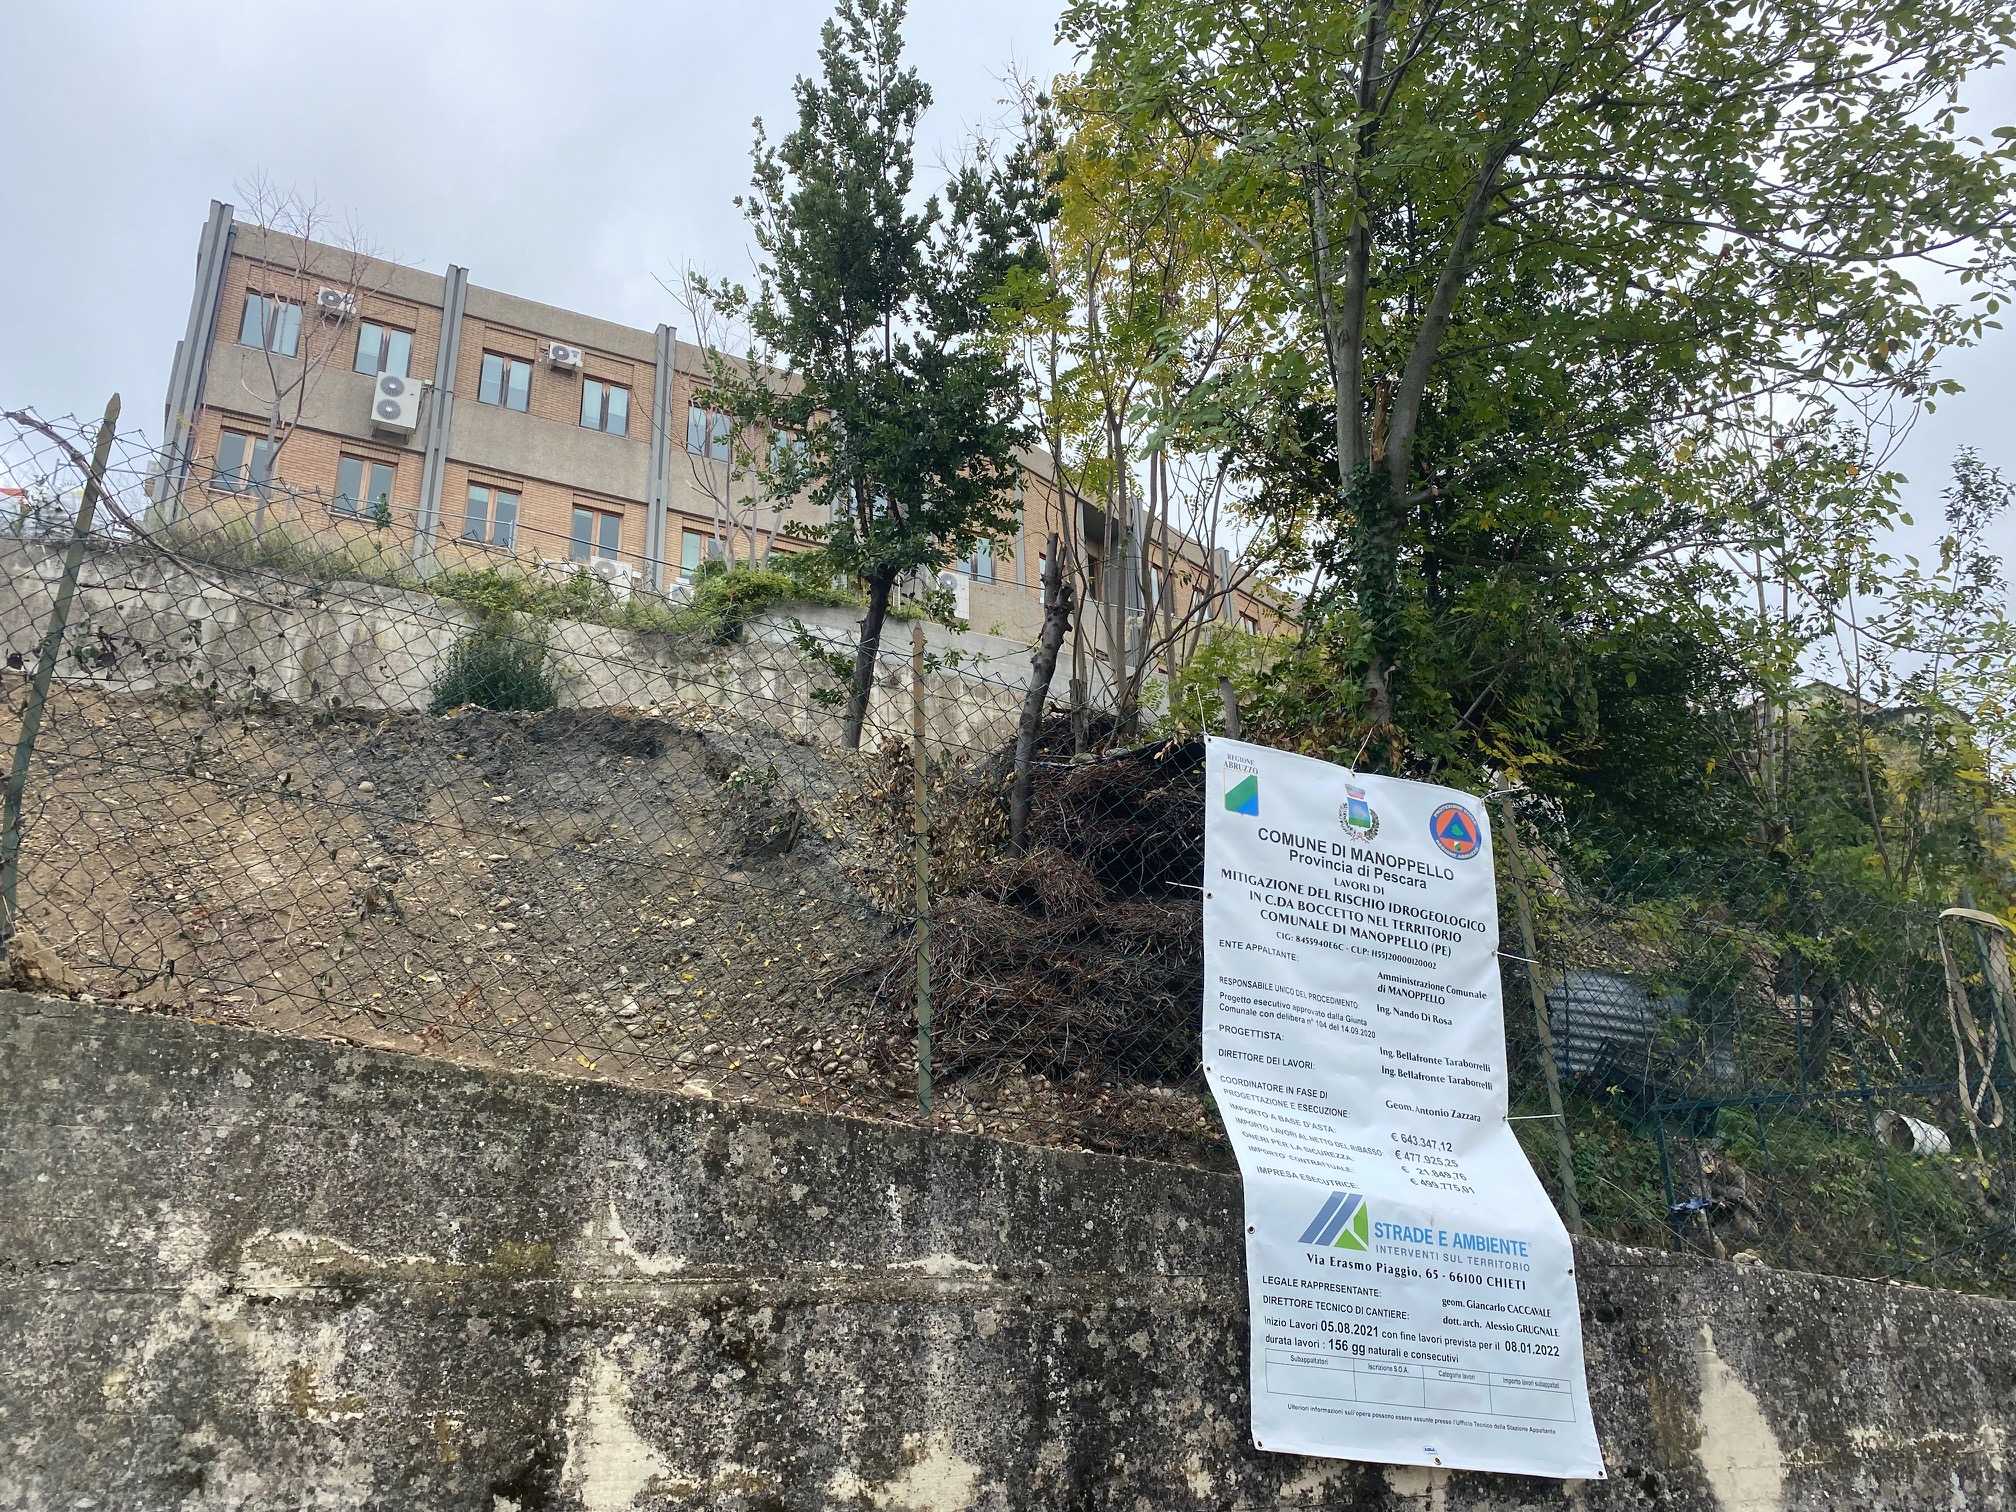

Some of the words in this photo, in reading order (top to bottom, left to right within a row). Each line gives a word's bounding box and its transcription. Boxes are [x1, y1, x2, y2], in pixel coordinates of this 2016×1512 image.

[1224, 761, 1259, 775] ABRUZZO
[1258, 827, 1327, 853] COMUNE
[1332, 843, 1346, 858] DI
[1351, 847, 1454, 881] MANOPPELLO
[1289, 850, 1353, 874] Provincia
[1358, 865, 1369, 877] di
[1374, 868, 1427, 889] Pescara
[1334, 877, 1370, 892] LAVORI
[1373, 885, 1384, 895] DI
[1221, 868, 1304, 895] MITIGAZIONE
[1308, 886, 1331, 900] DEL
[1334, 891, 1385, 911] RISCHIO
[1388, 902, 1486, 933] IDROGEOLOGICO
[1249, 890, 1262, 903] IN
[1265, 894, 1294, 909] C.DA
[1297, 901, 1364, 922] BOCCETTO
[1367, 914, 1389, 928] NEL
[1392, 919, 1462, 943] TERRITORIO
[1219, 939, 1243, 950] ENTE
[1260, 909, 1329, 932] COMUNALE
[1332, 923, 1346, 935] DI
[1350, 926, 1429, 952] MANOPPELLO
[1431, 942, 1452, 958] (PE)
[1276, 931, 1294, 941] CIG:
[1350, 945, 1370, 956] CUP:
[1219, 976, 1273, 992] RESPONSABILE
[1274, 984, 1295, 996] UNICO
[1295, 989, 1308, 1000] DEL
[1377, 971, 1445, 992] Amministrazione
[1446, 985, 1488, 1000] Comunale
[1377, 984, 1386, 993] di
[1388, 986, 1446, 1005] MANOPPELLO
[1219, 992, 1251, 1005] Progetto
[1253, 998, 1291, 1010] esecutivo
[1292, 1004, 1326, 1019] approvato
[1327, 1011, 1344, 1022] dalla
[1345, 1015, 1368, 1026] Giunta
[1219, 1003, 1257, 1017] Comunale
[1259, 1010, 1275, 1019] con
[1276, 1011, 1306, 1024] delibera
[1316, 1019, 1327, 1029] 104
[1329, 1021, 1340, 1032] del
[1376, 1003, 1392, 1016] Ing.
[1393, 1007, 1420, 1020] Nando
[1421, 1012, 1431, 1022] Di
[1432, 1015, 1453, 1026] Rosa
[1218, 1024, 1285, 1041] PROGETTISTA:
[1218, 1048, 1264, 1063] DIRETTORE
[1266, 1056, 1280, 1065] DEI
[1380, 1046, 1396, 1059] Ing.
[1445, 1057, 1491, 1073] Taraborrelli
[1220, 1075, 1283, 1093] COORDINATORE
[1285, 1086, 1294, 1095] IN
[1296, 1088, 1318, 1098] FASE
[1320, 1090, 1328, 1099] DI
[1381, 1065, 1397, 1078] Ing.
[1448, 1075, 1493, 1091] Taraborrelli
[1223, 1088, 1289, 1109] PROGETTAZIONE
[1291, 1102, 1296, 1110] E
[1385, 1099, 1414, 1112] Geom.
[1415, 1106, 1450, 1118] Antonio
[1451, 1109, 1481, 1122] Zazzara
[1229, 1103, 1269, 1118] IMPORTO
[1271, 1113, 1277, 1121] A
[1278, 1114, 1302, 1127] BASE
[1391, 1132, 1399, 1142] €
[1394, 1149, 1402, 1160] €
[1256, 1166, 1299, 1180] IMPRESA
[1401, 1165, 1410, 1174] €
[1410, 1177, 1419, 1186] €
[1374, 1221, 1433, 1245] STRADE
[1438, 1230, 1448, 1247] E
[1452, 1232, 1529, 1258] AMBIENTE
[1375, 1244, 1439, 1261] INTERVENTI
[1443, 1253, 1463, 1264] SUL
[1467, 1256, 1531, 1272] TERRITORIO
[1306, 1253, 1325, 1266] Via
[1329, 1256, 1372, 1272] Erasmo
[1425, 1268, 1439, 1280] 65
[1449, 1271, 1483, 1285] 66100
[1486, 1276, 1527, 1291] CHIETI
[1262, 1275, 1299, 1288] LEGALE
[1300, 1279, 1382, 1297] RAPPRESENTANTE:
[1263, 1295, 1313, 1309] DIRETTORE
[1316, 1301, 1353, 1314] TECNICO
[1355, 1305, 1364, 1315] DI
[1366, 1307, 1410, 1320] CANTIERE:
[1442, 1298, 1466, 1308] geom.
[1466, 1299, 1506, 1313] Giancarlo
[1507, 1304, 1551, 1318] CACCAVALE
[1264, 1316, 1287, 1328] Inizio
[1289, 1318, 1318, 1331] Lavori
[1320, 1320, 1379, 1338] 05.08.2021
[1381, 1330, 1398, 1340] con
[1400, 1331, 1416, 1342] fine
[1418, 1333, 1443, 1345] lavori
[1444, 1337, 1477, 1348] prevista
[1478, 1341, 1492, 1351] per
[1494, 1341, 1500, 1351] il
[1504, 1340, 1560, 1357] 08.01.2022
[1442, 1316, 1462, 1327] dott.
[1462, 1319, 1483, 1329] arch.
[1485, 1320, 1515, 1332] Alessio
[1516, 1323, 1560, 1338] GRUGNALE
[1265, 1334, 1292, 1346] durata
[1294, 1337, 1320, 1349] lavori
[1328, 1338, 1349, 1352] 156
[1351, 1343, 1366, 1356] gg
[1368, 1346, 1401, 1358] naturali
[1410, 1351, 1459, 1364] consecutivi
[1287, 1403, 1310, 1412] Ulteriori
[1311, 1404, 1344, 1416] informazioni
[1372, 1412, 1395, 1421] possono
[1395, 1414, 1413, 1422] essere
[1413, 1416, 1434, 1424] assunte
[1434, 1418, 1452, 1427] presso
